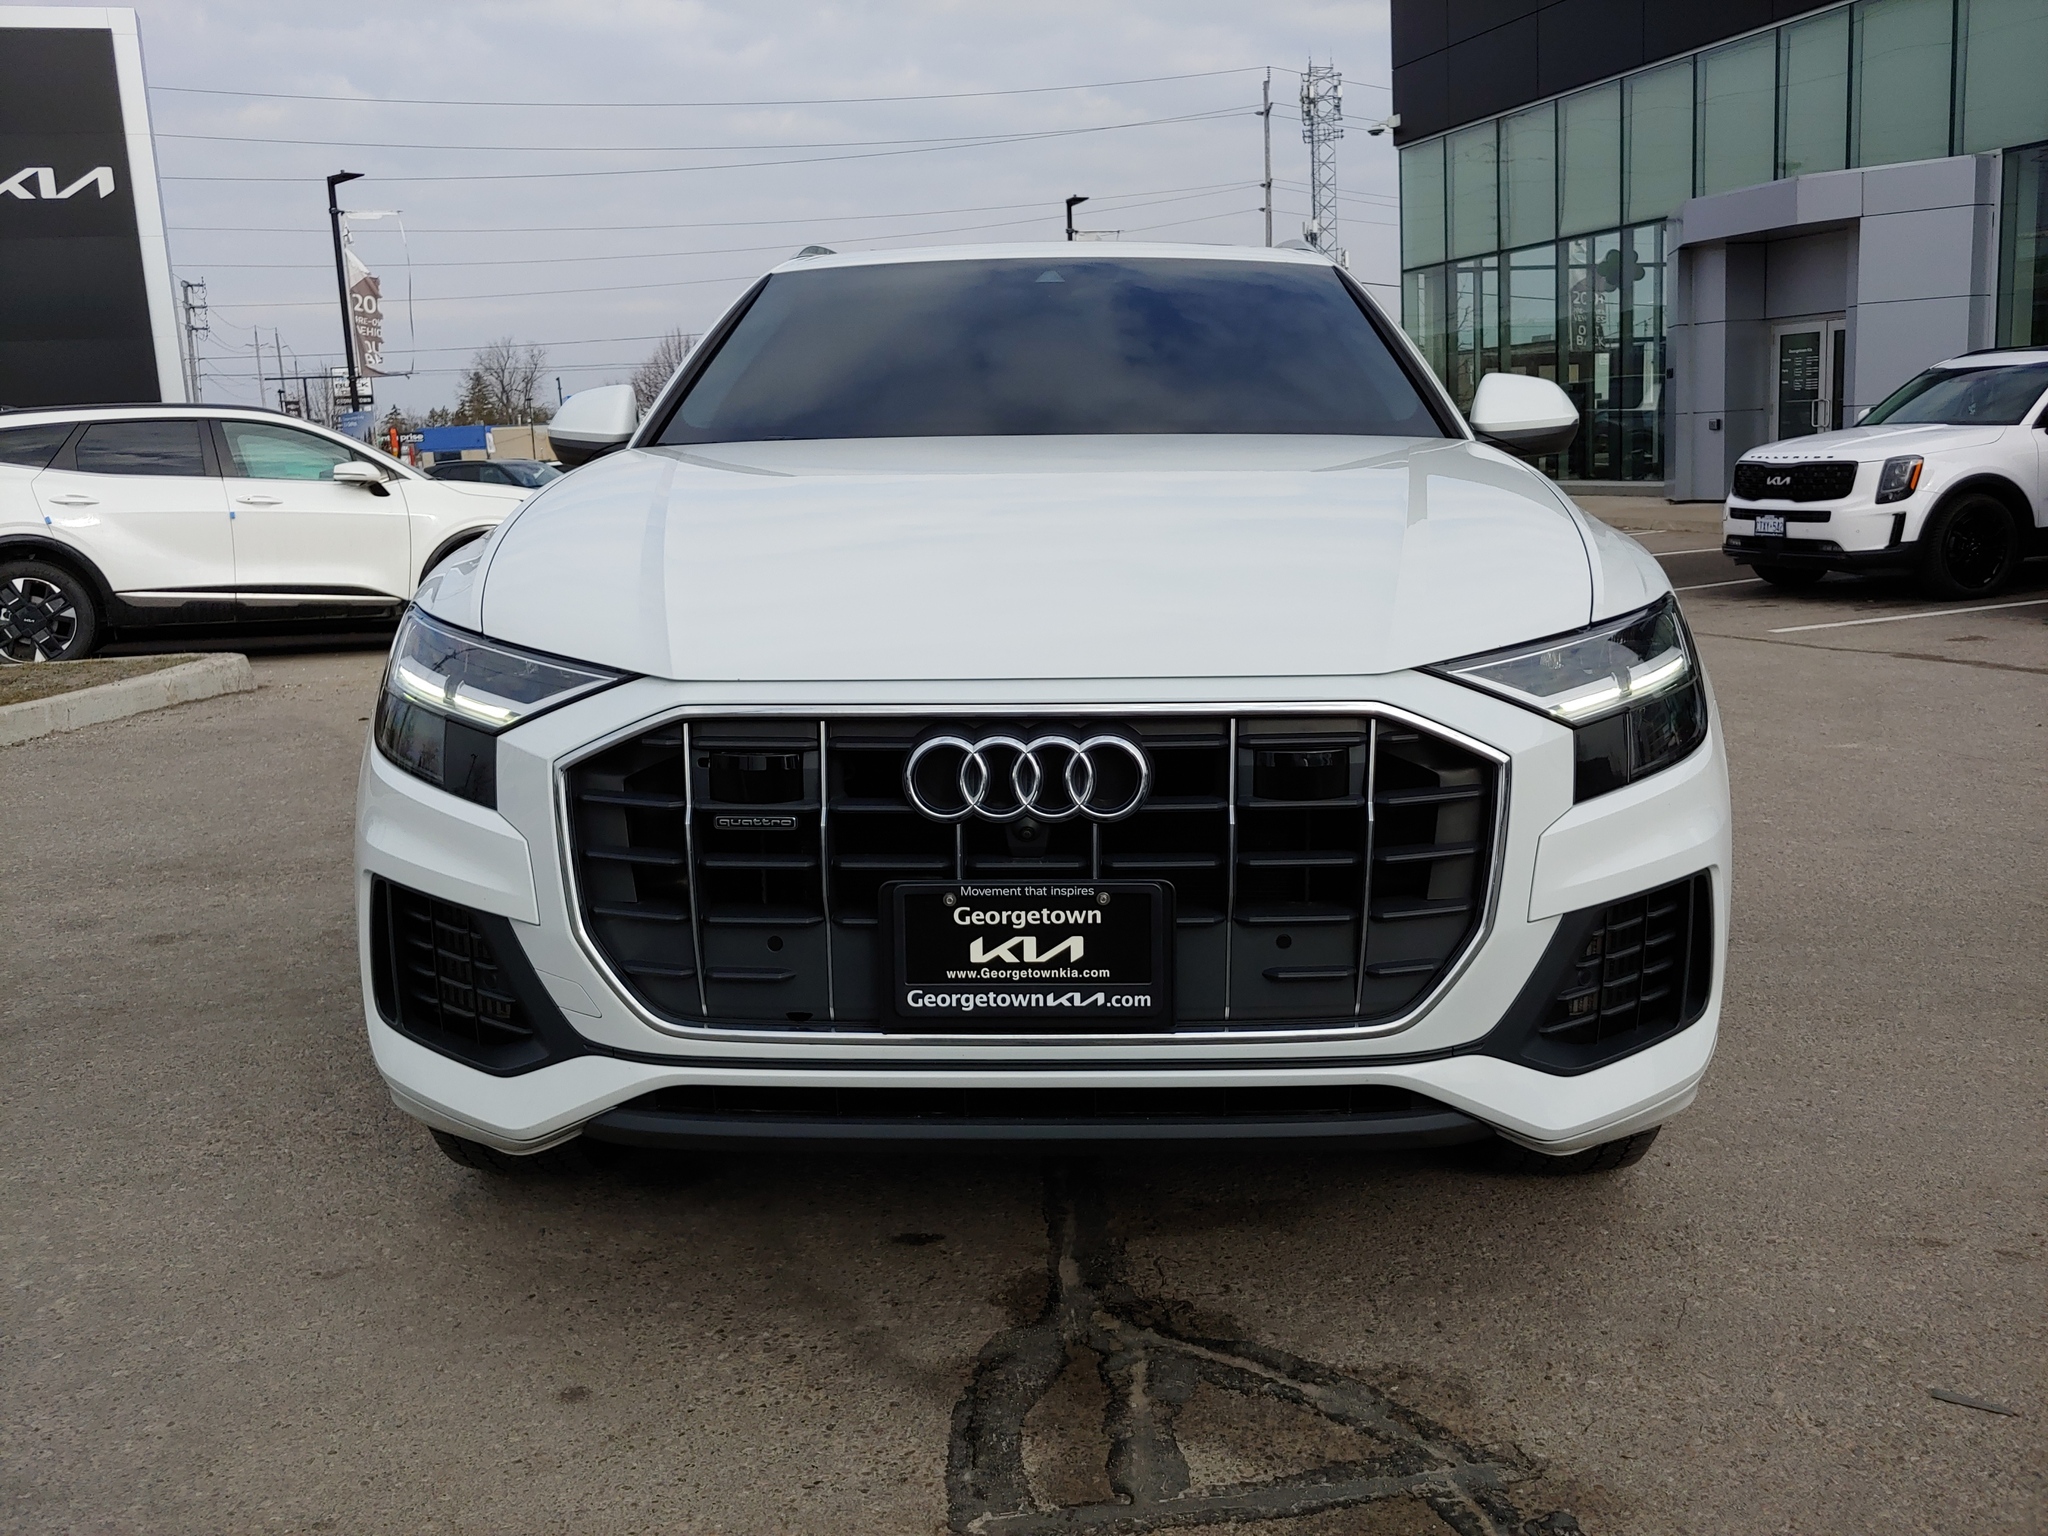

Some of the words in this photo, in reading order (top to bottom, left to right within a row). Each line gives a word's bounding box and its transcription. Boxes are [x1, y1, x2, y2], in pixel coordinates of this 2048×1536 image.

[1766, 476, 1791, 486] KIA
[719, 818, 792, 827] quattro
[960, 886, 1022, 897] Movement
[1025, 886, 1048, 896] that
[1051, 886, 1095, 898] inspires
[953, 907, 1102, 929] Georgetown
[970, 936, 1084, 963] KIA
[946, 967, 1110, 980] www.Georgetownkia.com
